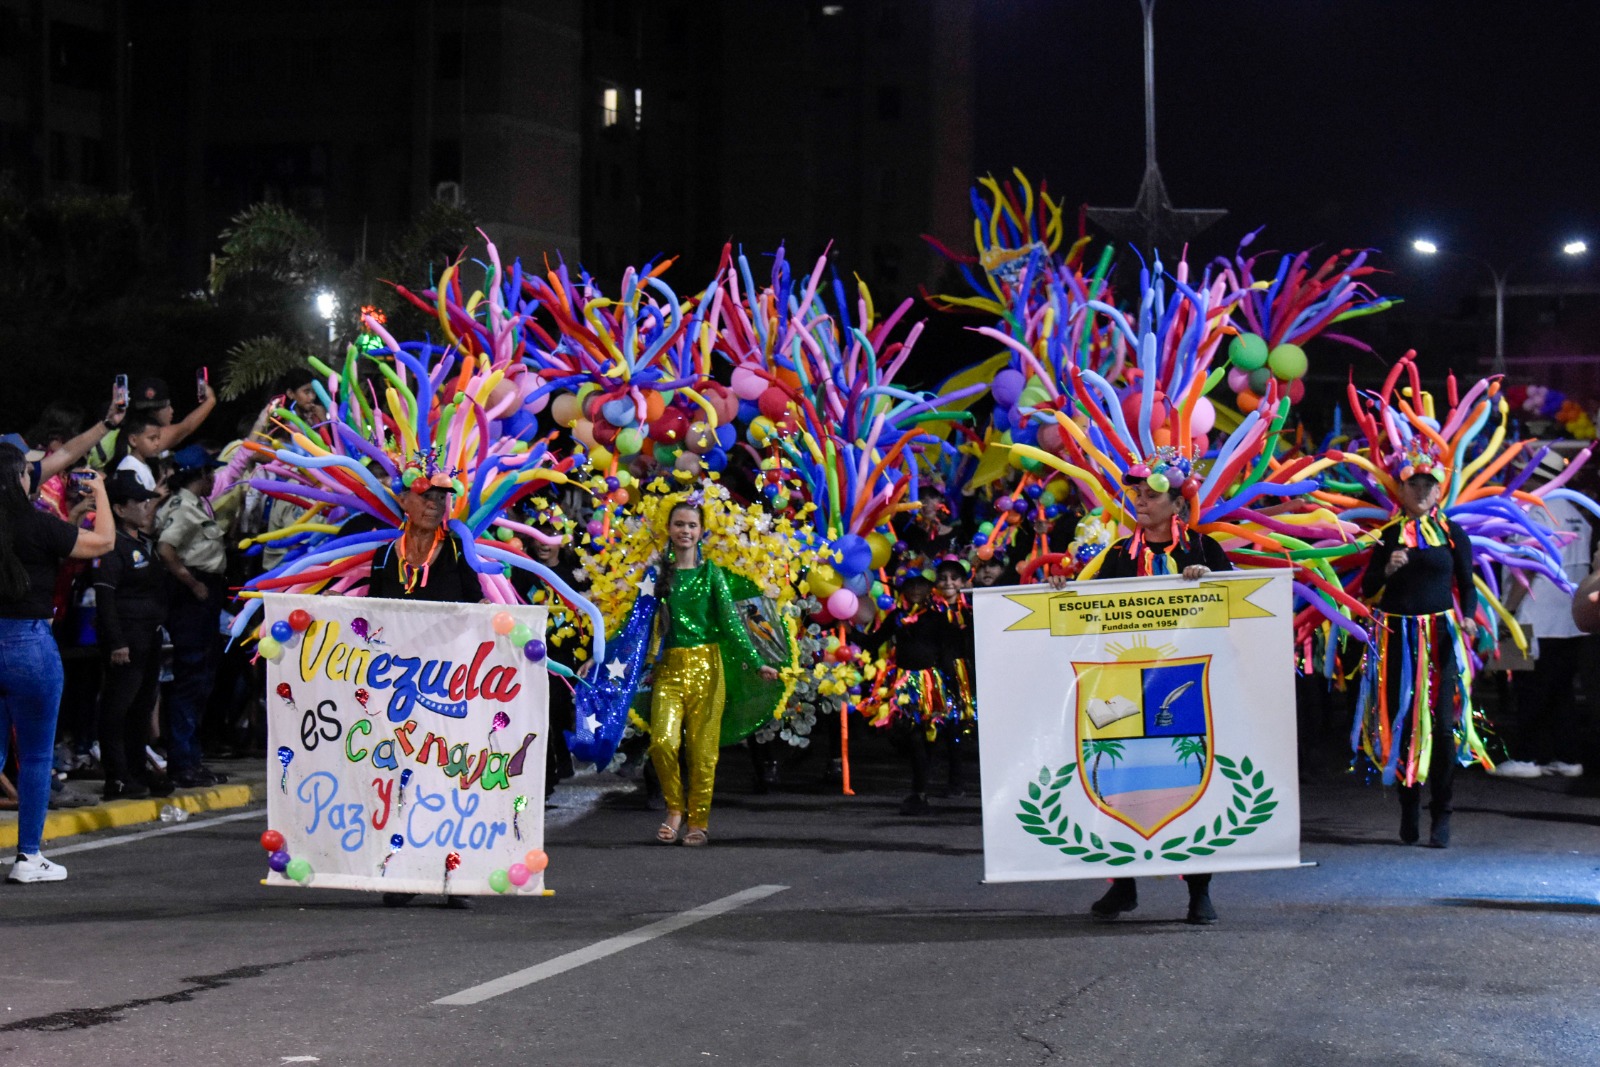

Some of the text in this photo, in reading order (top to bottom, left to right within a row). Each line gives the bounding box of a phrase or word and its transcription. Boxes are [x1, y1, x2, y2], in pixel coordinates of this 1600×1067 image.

[1058, 593, 1224, 612] ESCUELA BÁSICA ESTADAL
[1105, 610, 1133, 621] LUIS
[1102, 620, 1178, 631] Fundada en 1954
[300, 619, 521, 722] Venezuela
[345, 719, 537, 790] Carnaval
[297, 771, 366, 851] Paz
